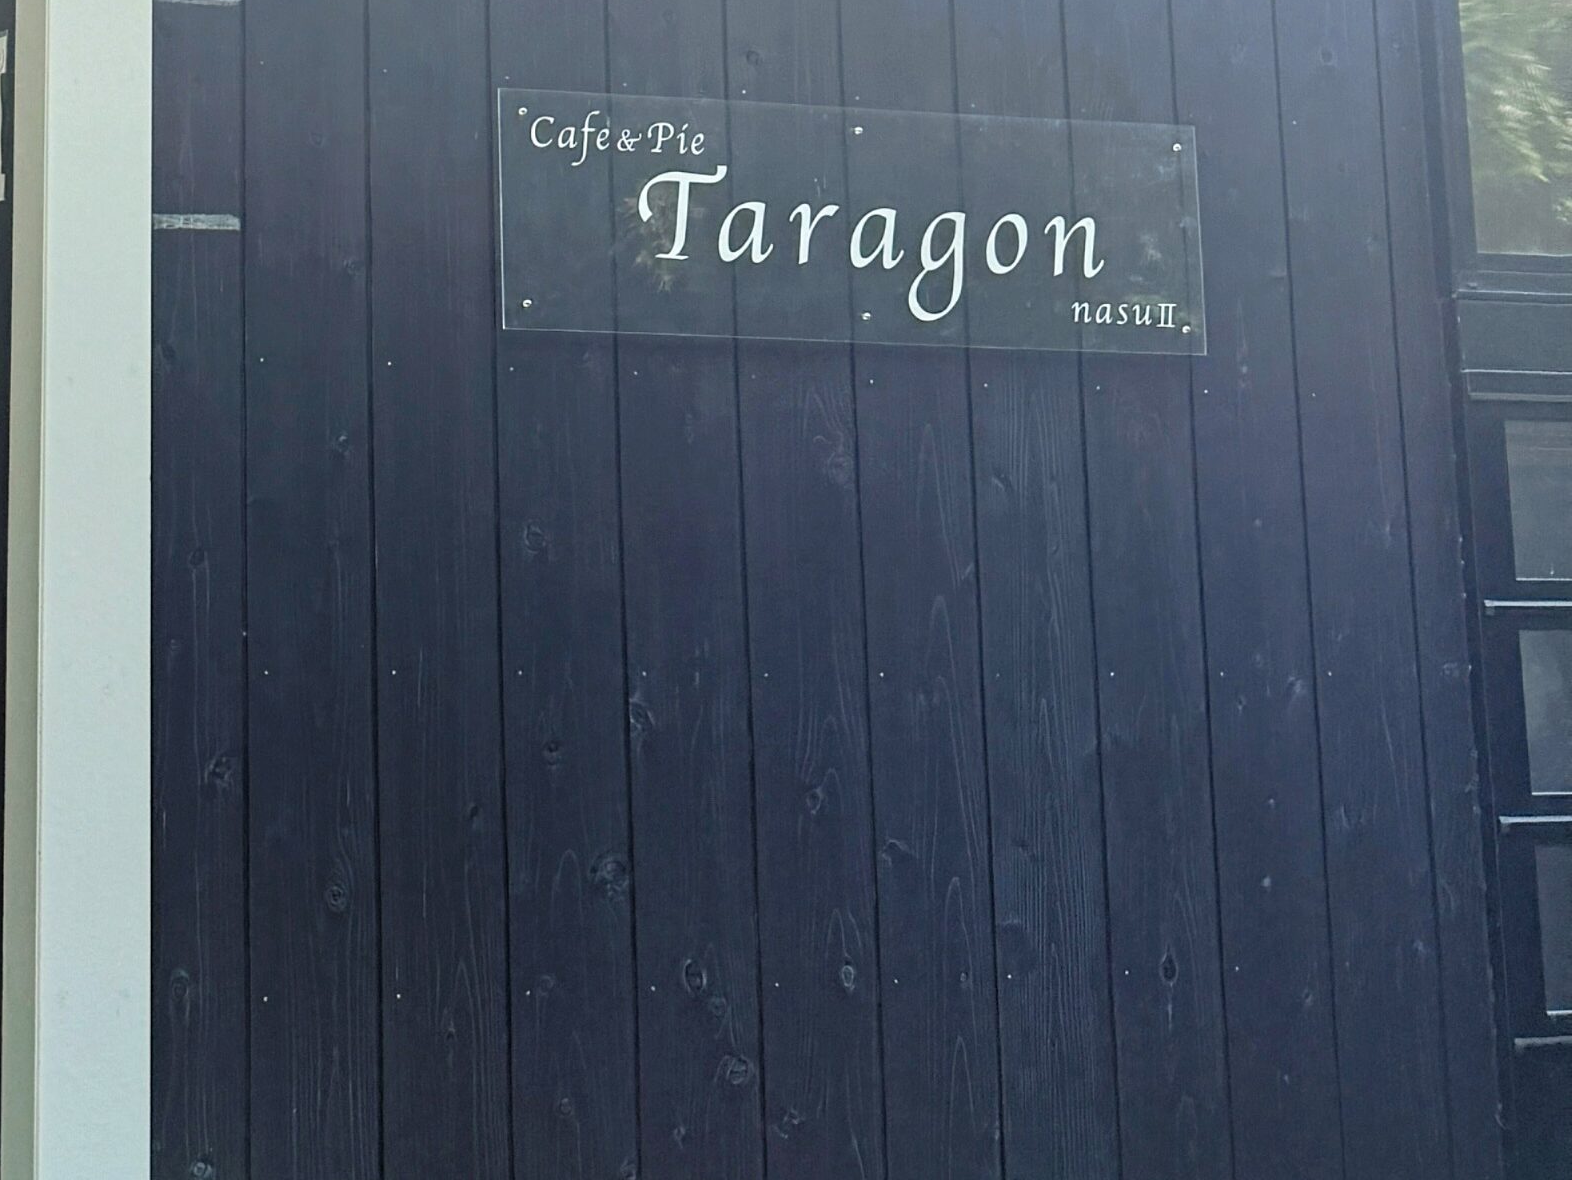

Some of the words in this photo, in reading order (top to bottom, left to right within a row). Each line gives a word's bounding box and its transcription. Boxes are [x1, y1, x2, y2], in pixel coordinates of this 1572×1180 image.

[530, 110, 610, 167] Cafe
[616, 128, 642, 152] &
[647, 122, 705, 155] Pie
[637, 164, 1106, 322] Taragon
